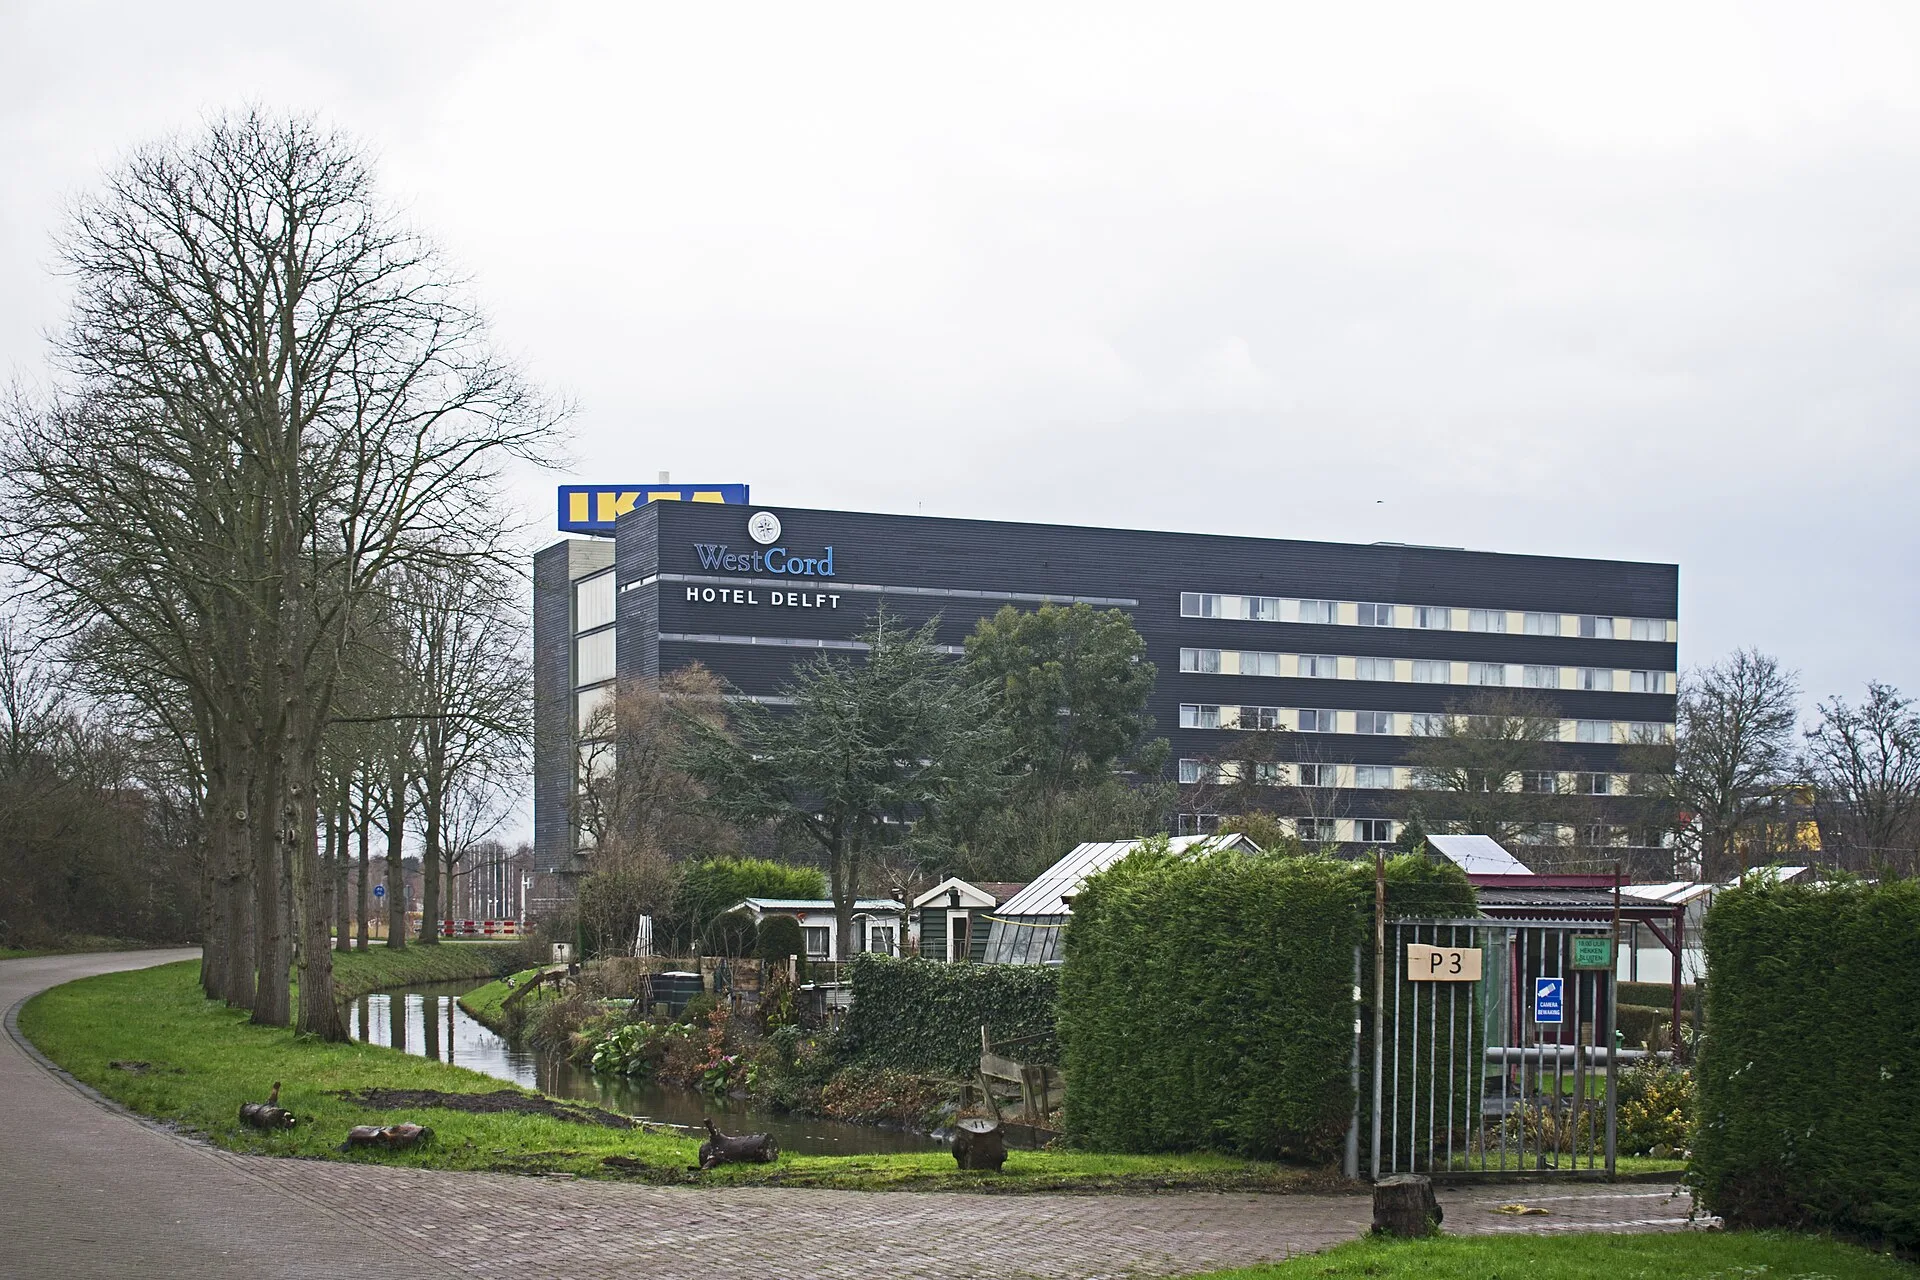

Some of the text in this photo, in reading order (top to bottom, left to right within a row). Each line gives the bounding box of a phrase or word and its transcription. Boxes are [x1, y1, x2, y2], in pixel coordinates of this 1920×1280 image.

[569, 492, 725, 521] IK
[694, 544, 835, 576] WestCord
[686, 587, 840, 609] HOTEL DELFT
[1430, 953, 1462, 974] P 3
